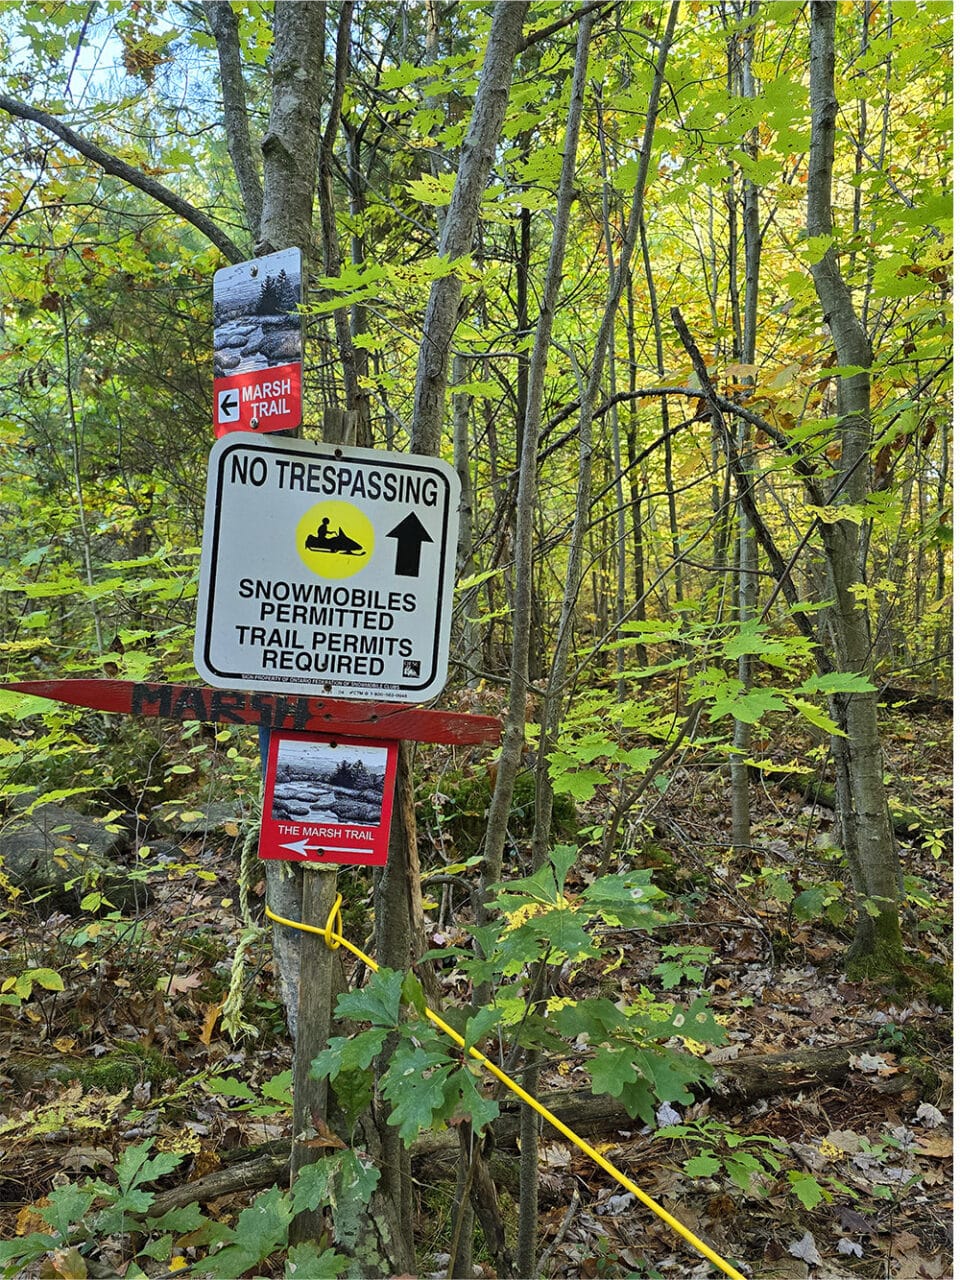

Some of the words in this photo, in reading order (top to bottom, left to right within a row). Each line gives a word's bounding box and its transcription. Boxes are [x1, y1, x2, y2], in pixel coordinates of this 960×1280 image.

[242, 378, 291, 402] MARSH
[251, 400, 290, 419] TRAIL
[231, 455, 268, 487] NO
[275, 460, 438, 507] TRESPASSING
[238, 578, 417, 612] SNOWMOBILES
[260, 603, 394, 631] PERMITTED
[235, 625, 304, 649] TRAIL
[312, 632, 413, 657] PERMITS
[262, 650, 385, 676] REQUIRED
[351, 681, 383, 689] SNOWMOBILE
[131, 682, 312, 729] MARSH
[278, 825, 300, 837] THE
[302, 827, 343, 839] MARSH
[344, 829, 375, 841] TRAIL
